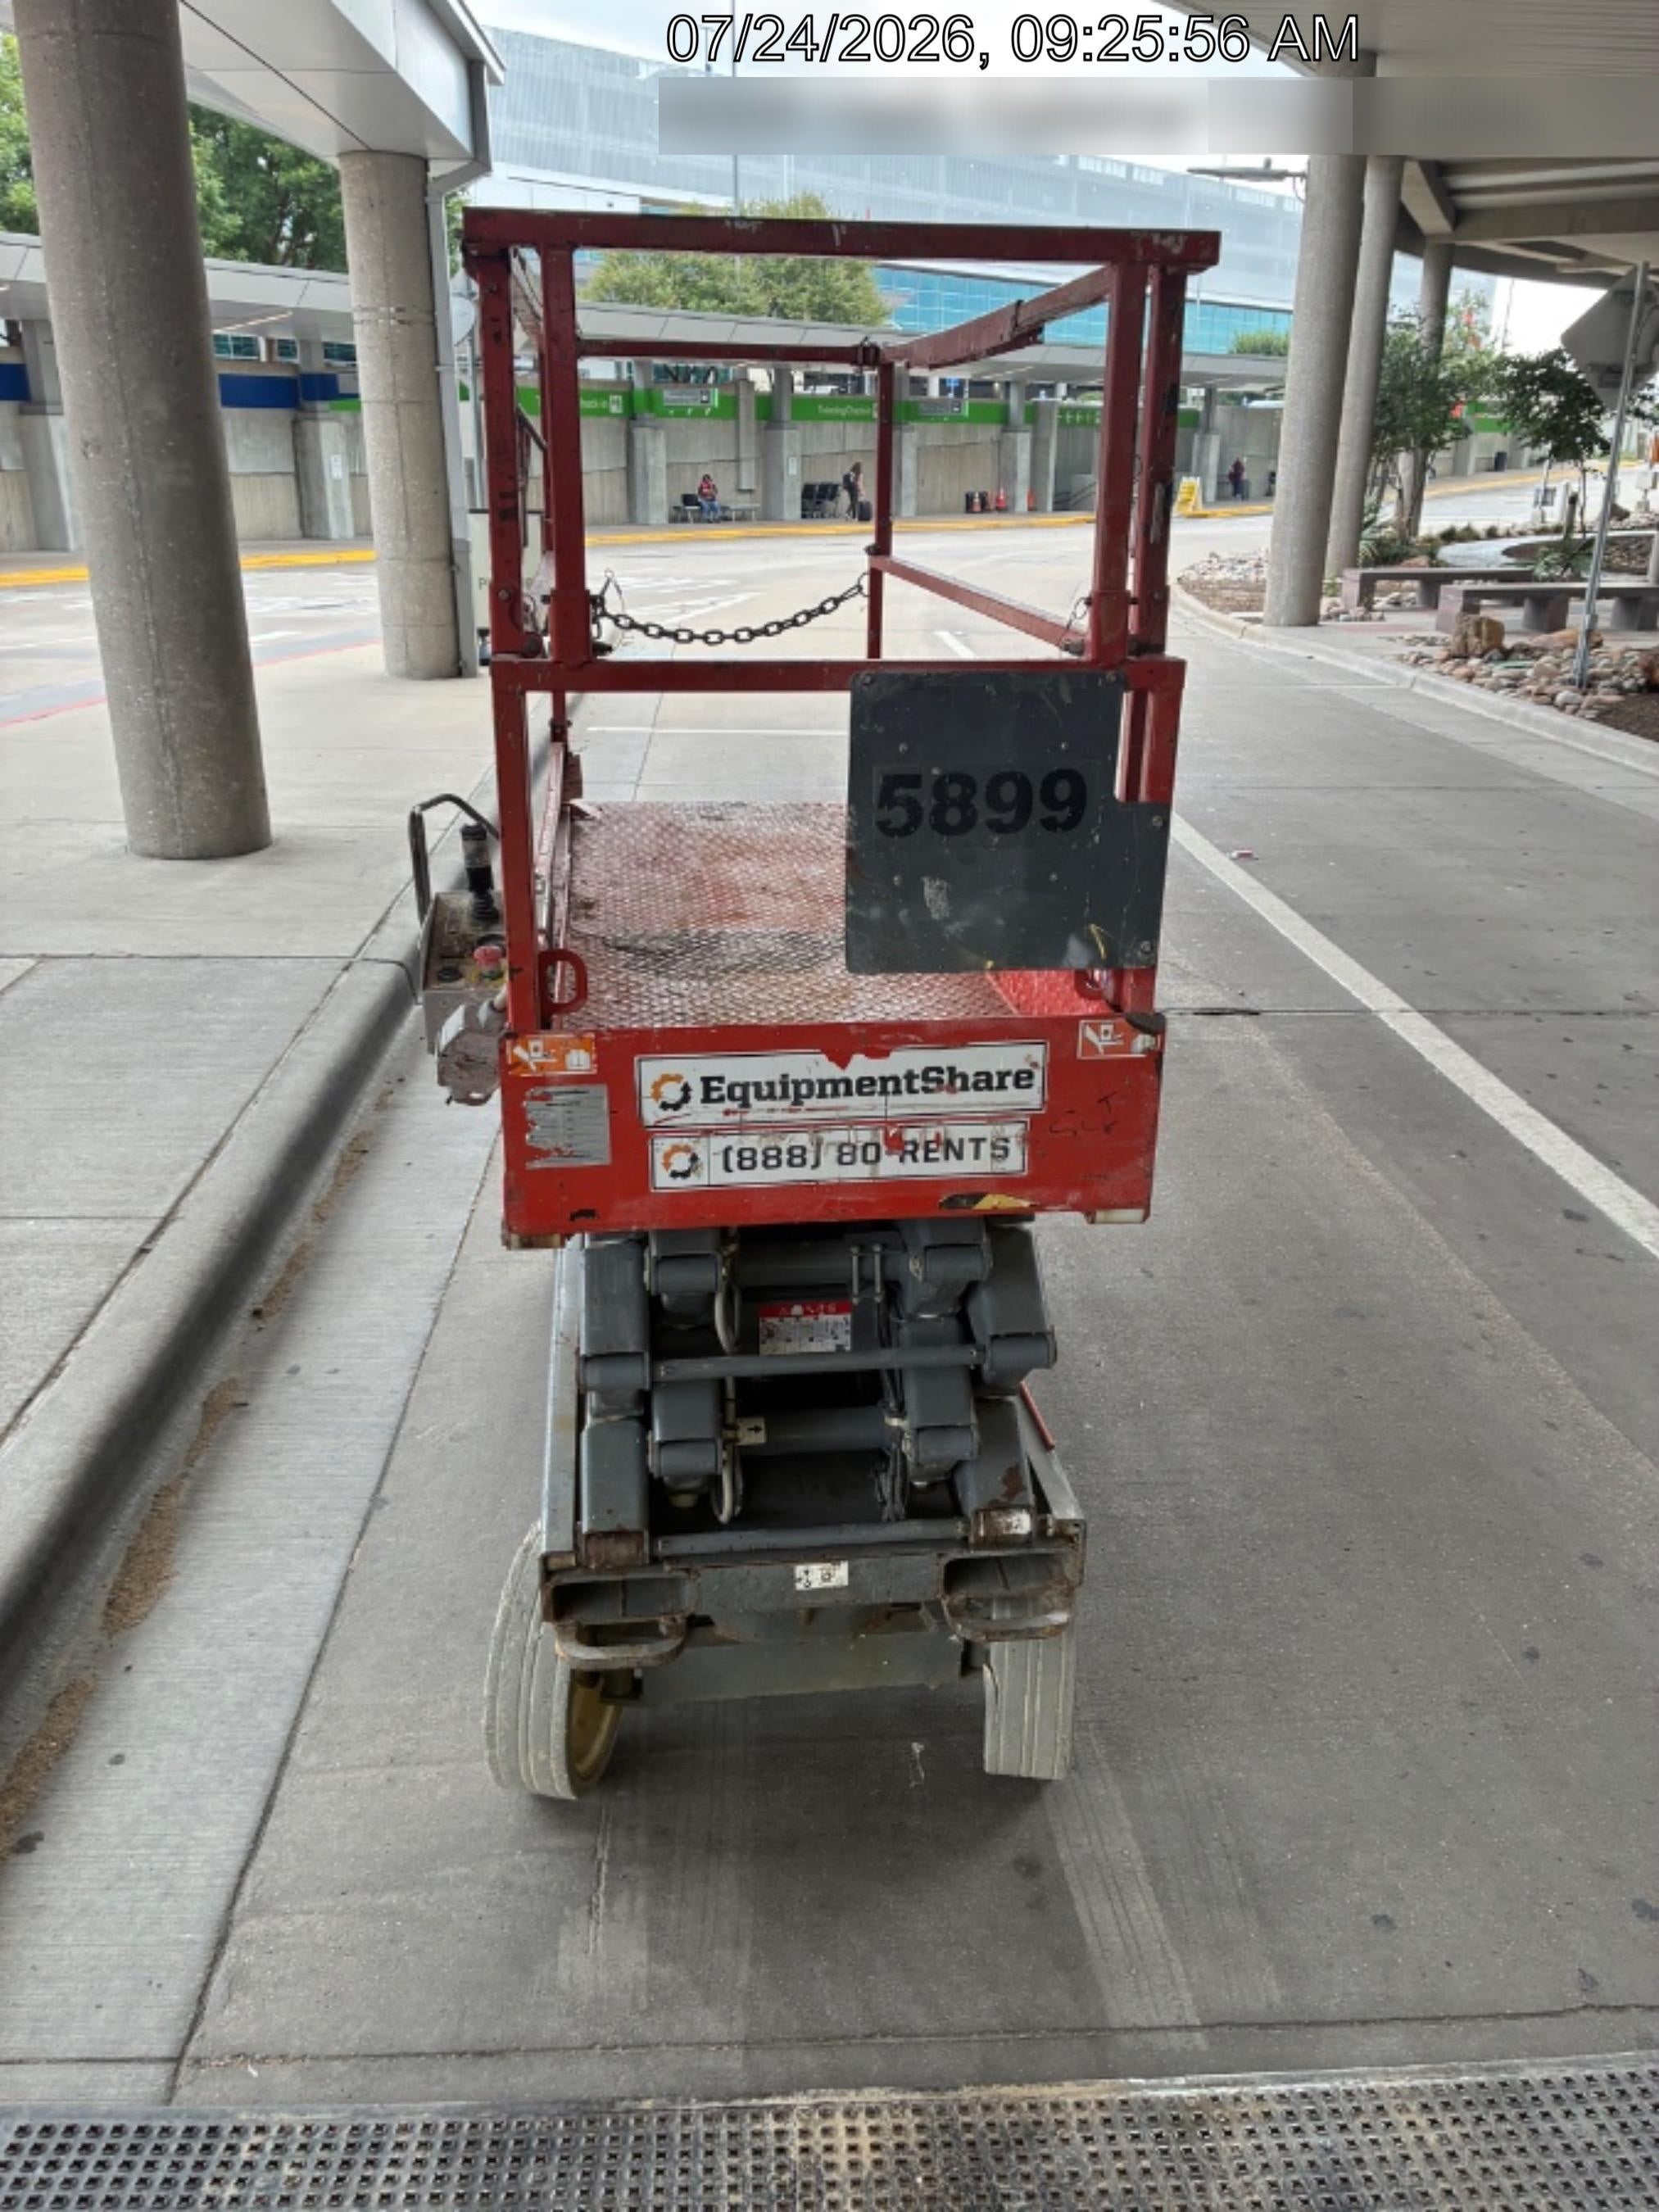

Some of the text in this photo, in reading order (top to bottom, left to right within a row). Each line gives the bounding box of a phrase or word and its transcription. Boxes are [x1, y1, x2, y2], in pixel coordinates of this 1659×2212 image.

[874, 768, 1087, 839] 5899
[700, 1066, 1036, 1108] EquipmentShare
[723, 1135, 824, 1173] (888)
